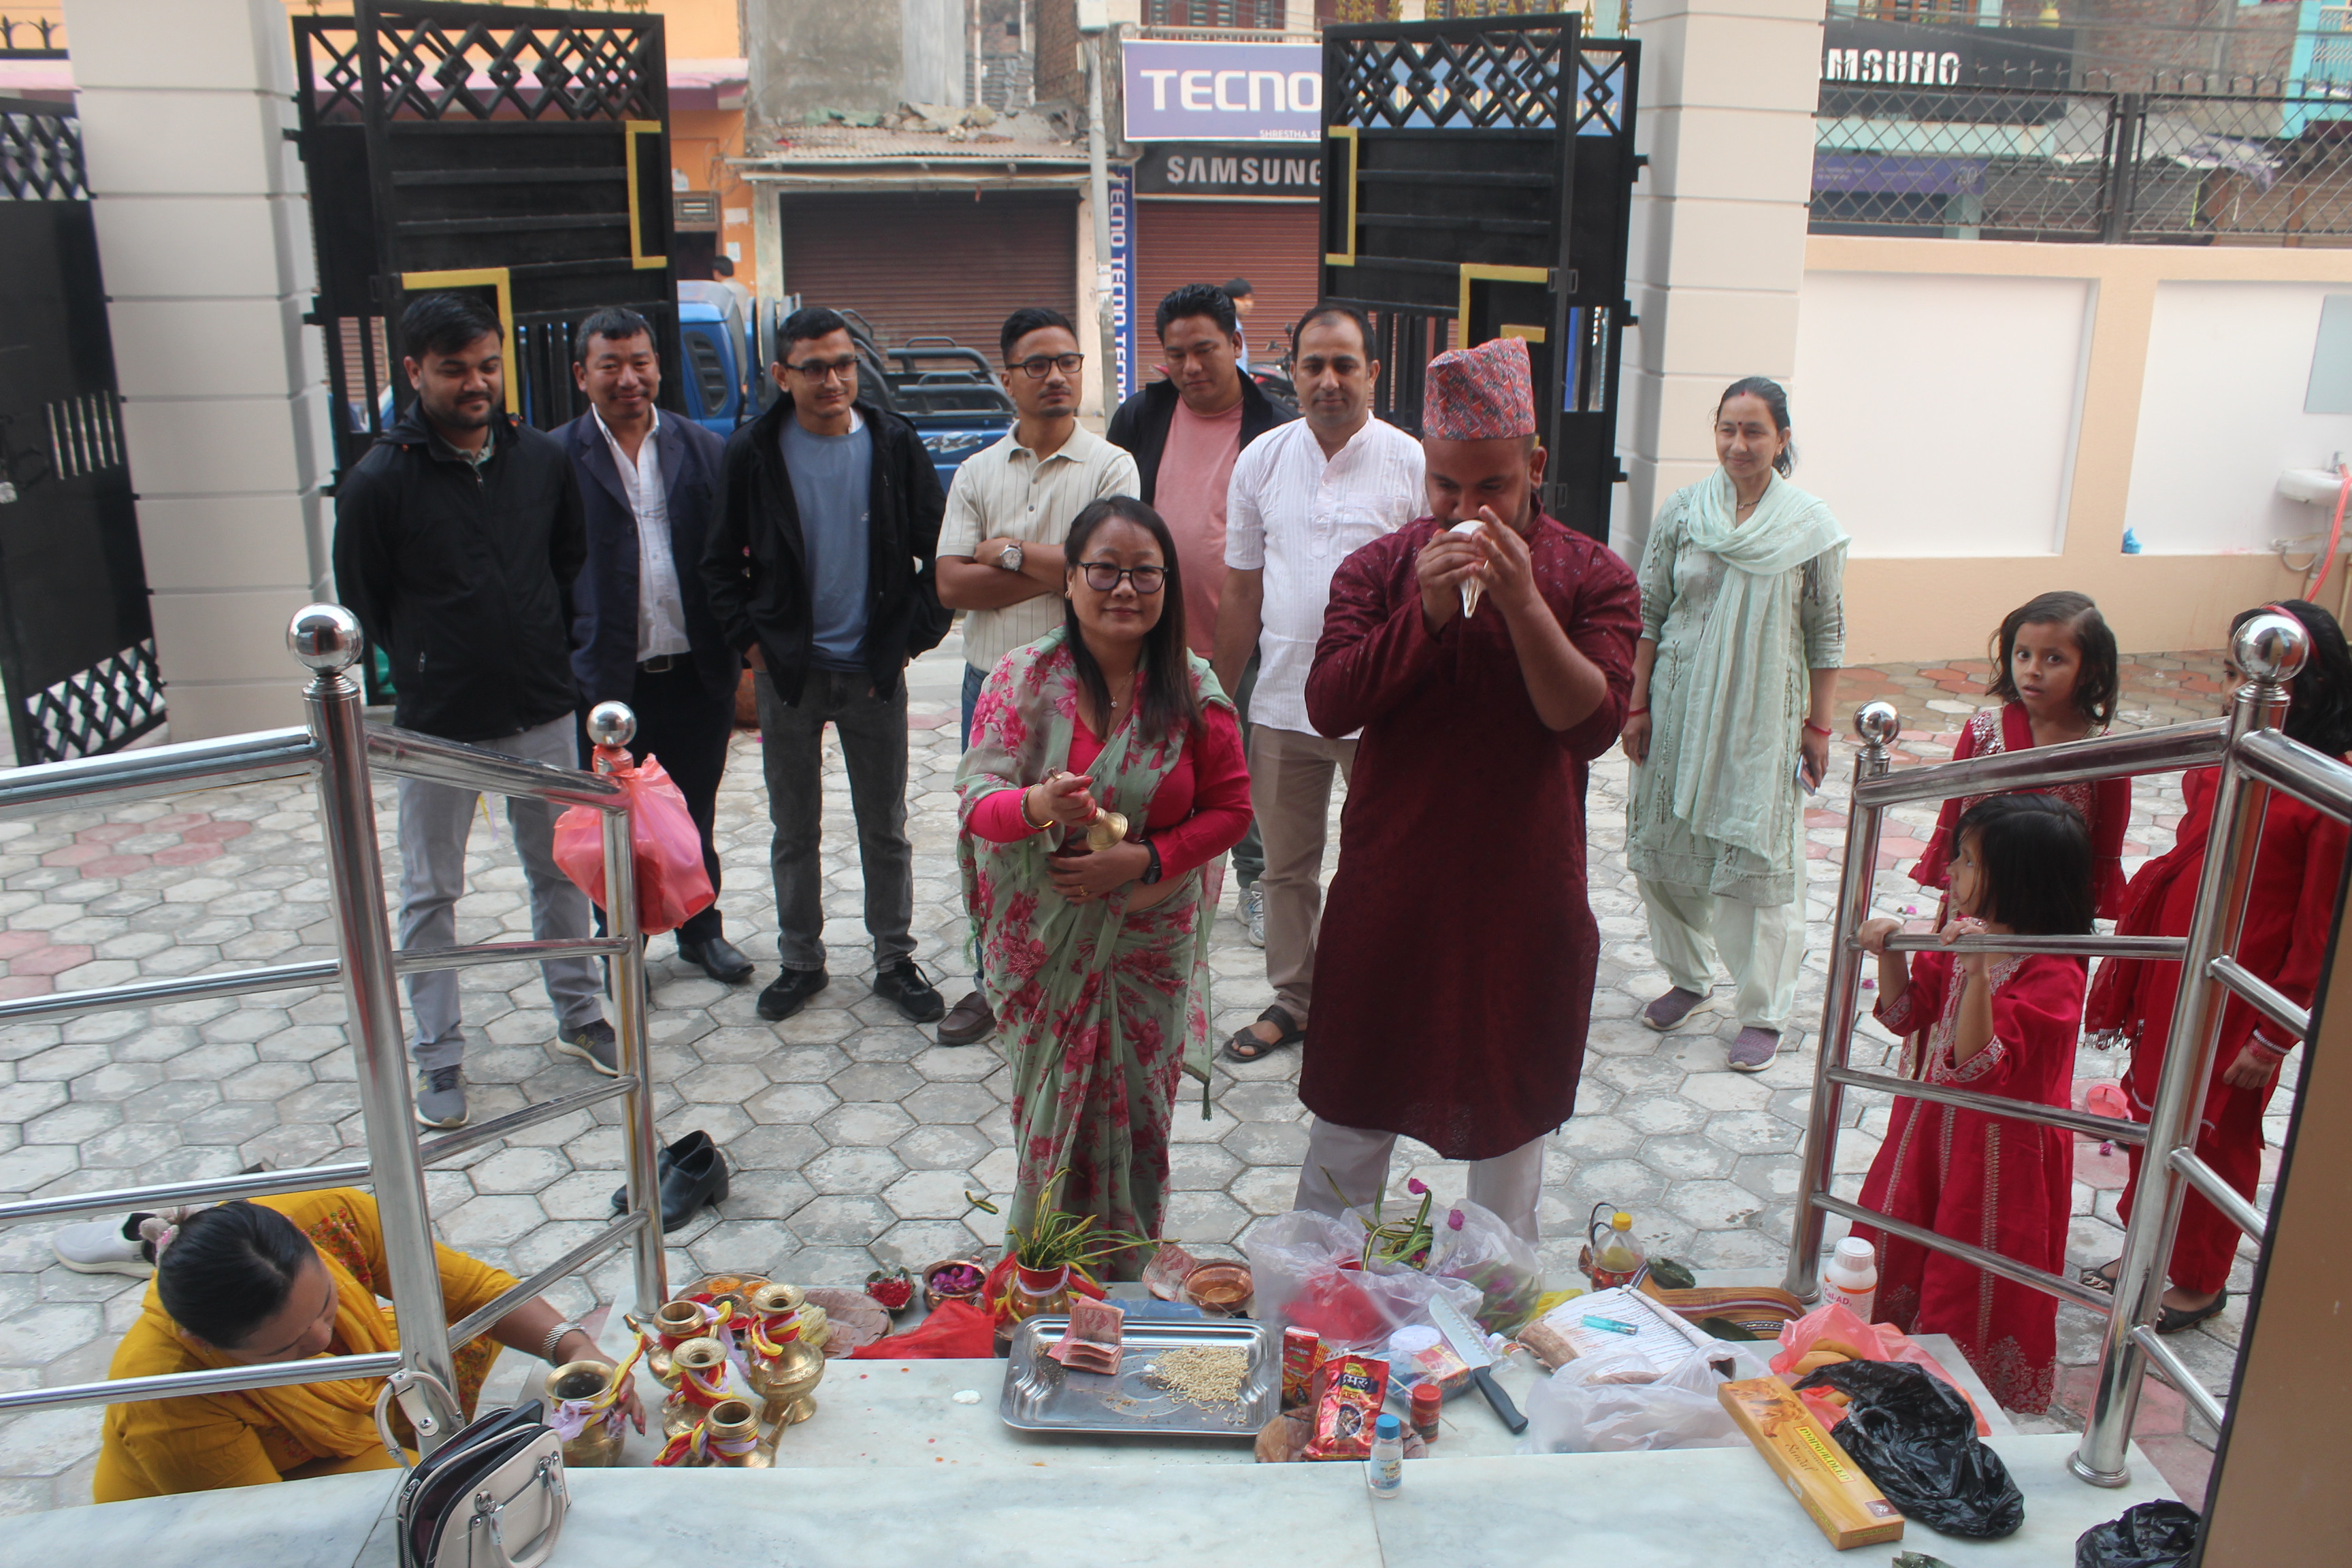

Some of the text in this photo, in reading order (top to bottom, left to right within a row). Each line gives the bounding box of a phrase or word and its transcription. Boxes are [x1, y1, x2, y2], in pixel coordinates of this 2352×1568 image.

[1140, 69, 1321, 112] TECNO
[1260, 129, 1307, 138] SHRESTHA
[1785, 1443, 1818, 1472] Sandal
